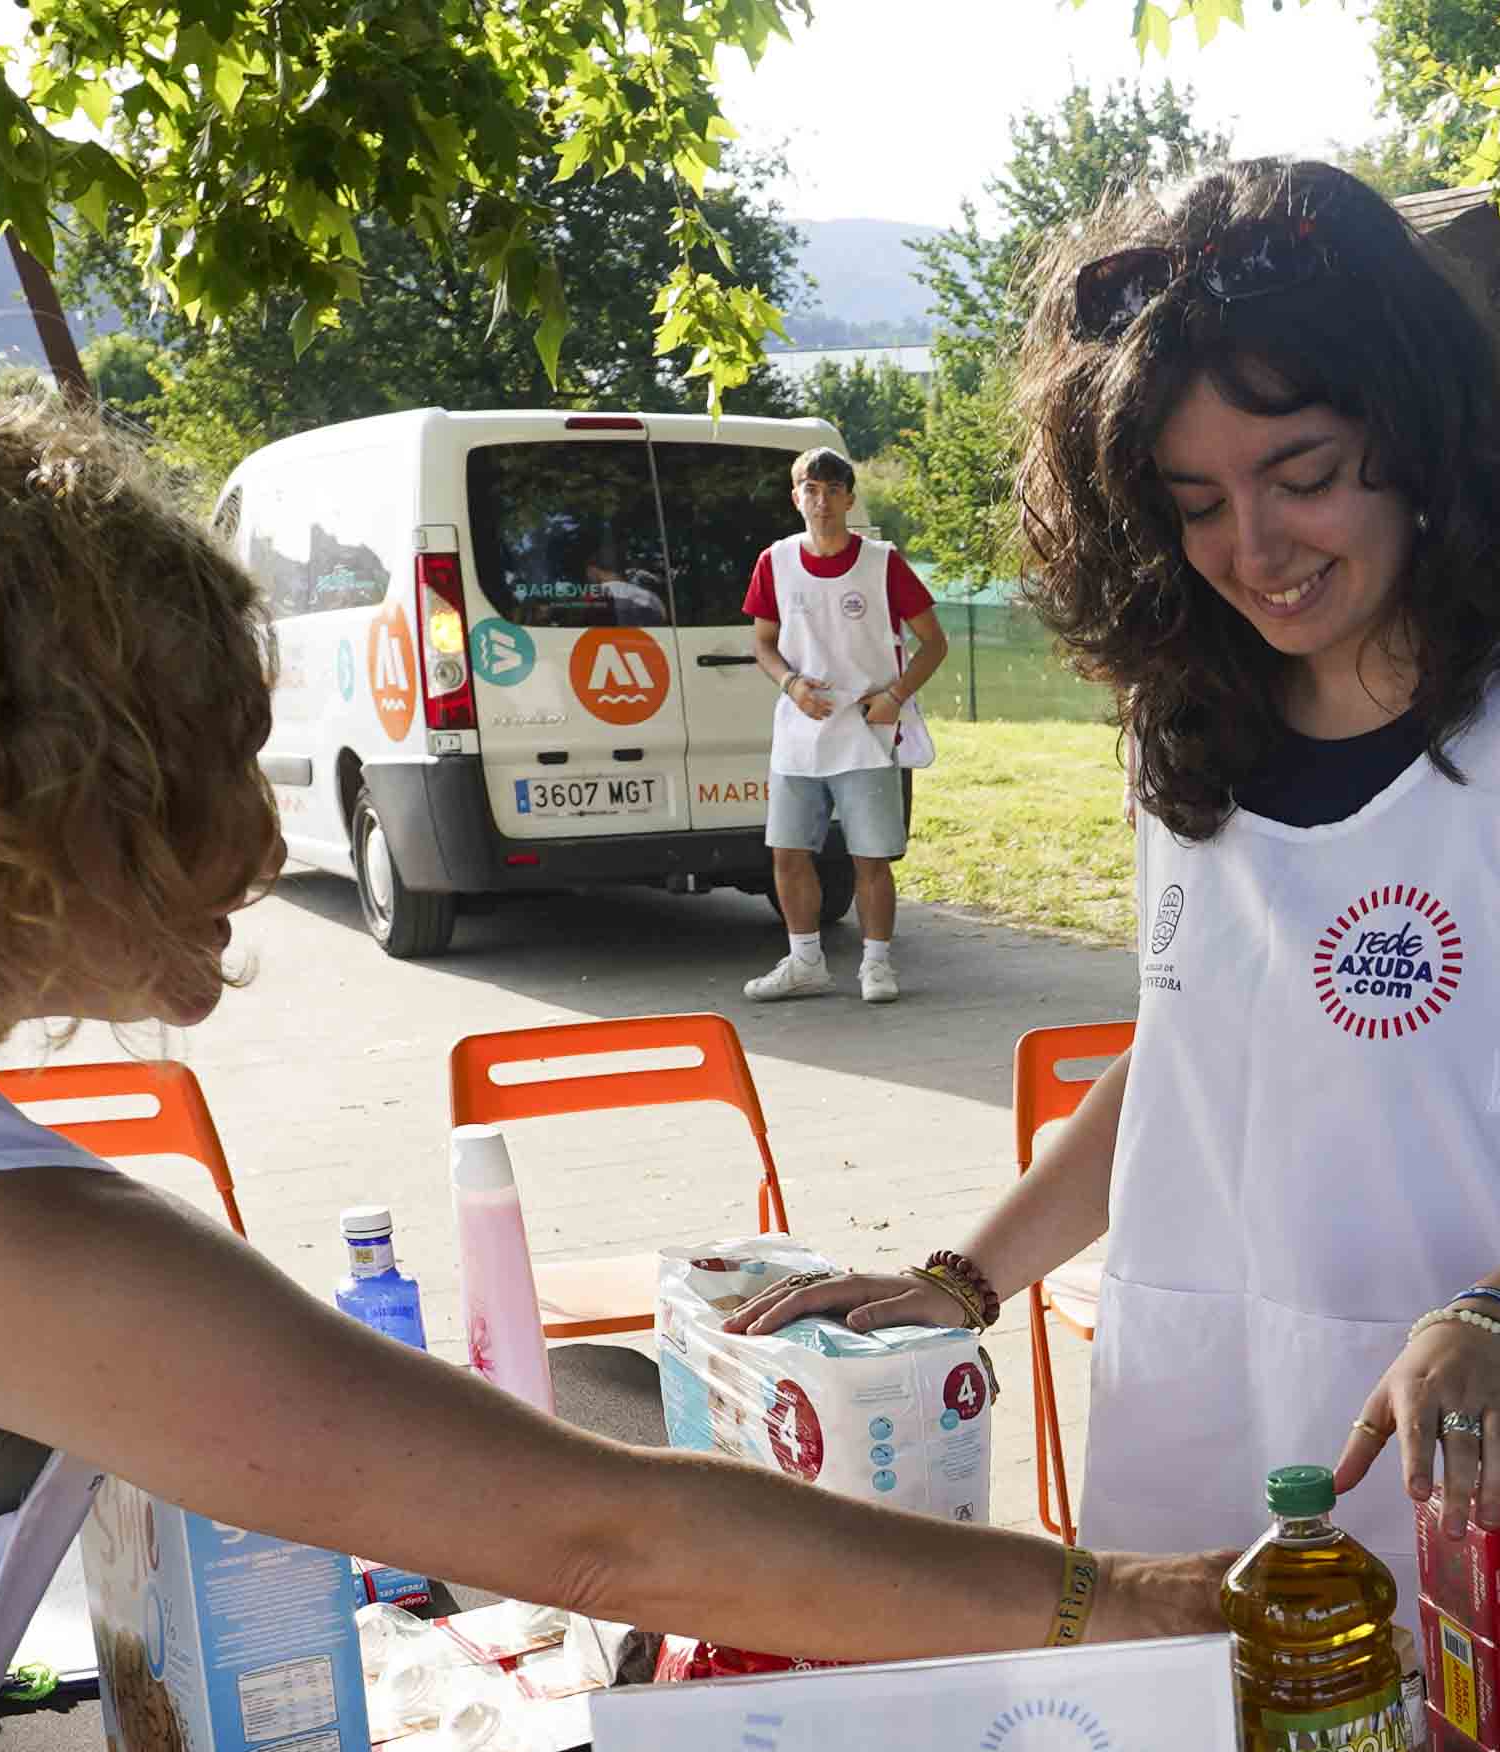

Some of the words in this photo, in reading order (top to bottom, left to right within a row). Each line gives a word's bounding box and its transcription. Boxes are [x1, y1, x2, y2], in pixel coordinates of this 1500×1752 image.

[534, 782, 599, 808] 3607
[608, 779, 657, 804] MGT
[1354, 922, 1424, 957] rede
[1336, 955, 1433, 983] AXUDA
[1345, 979, 1413, 999] .com
[956, 1375, 979, 1407] 4
